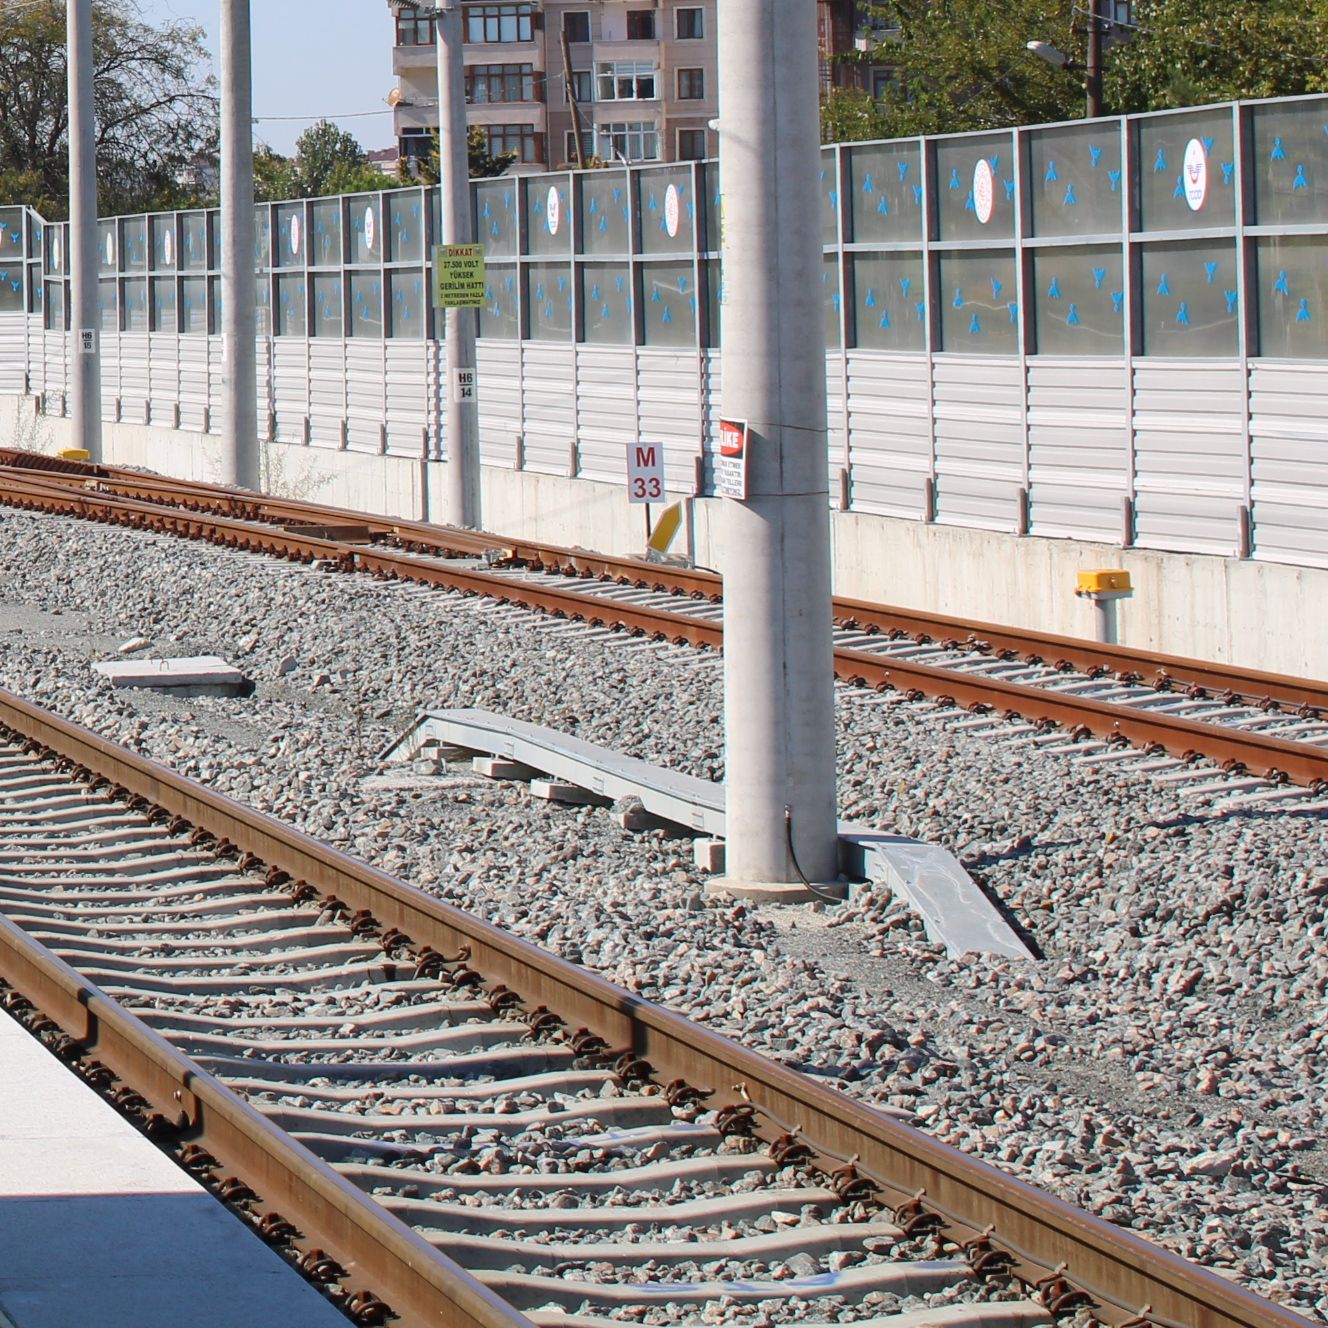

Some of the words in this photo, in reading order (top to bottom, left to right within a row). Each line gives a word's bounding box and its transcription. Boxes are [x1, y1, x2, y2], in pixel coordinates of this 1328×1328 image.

[448, 248, 472, 257] DİKKAT
[444, 261, 462, 269] 27.500
[450, 270, 474, 279] YÜKSEK
[440, 281, 465, 290] GERİLİM
[459, 373, 473, 383] H6
[461, 387, 472, 398] 14
[636, 447, 656, 467] M
[634, 478, 661, 498] 33
